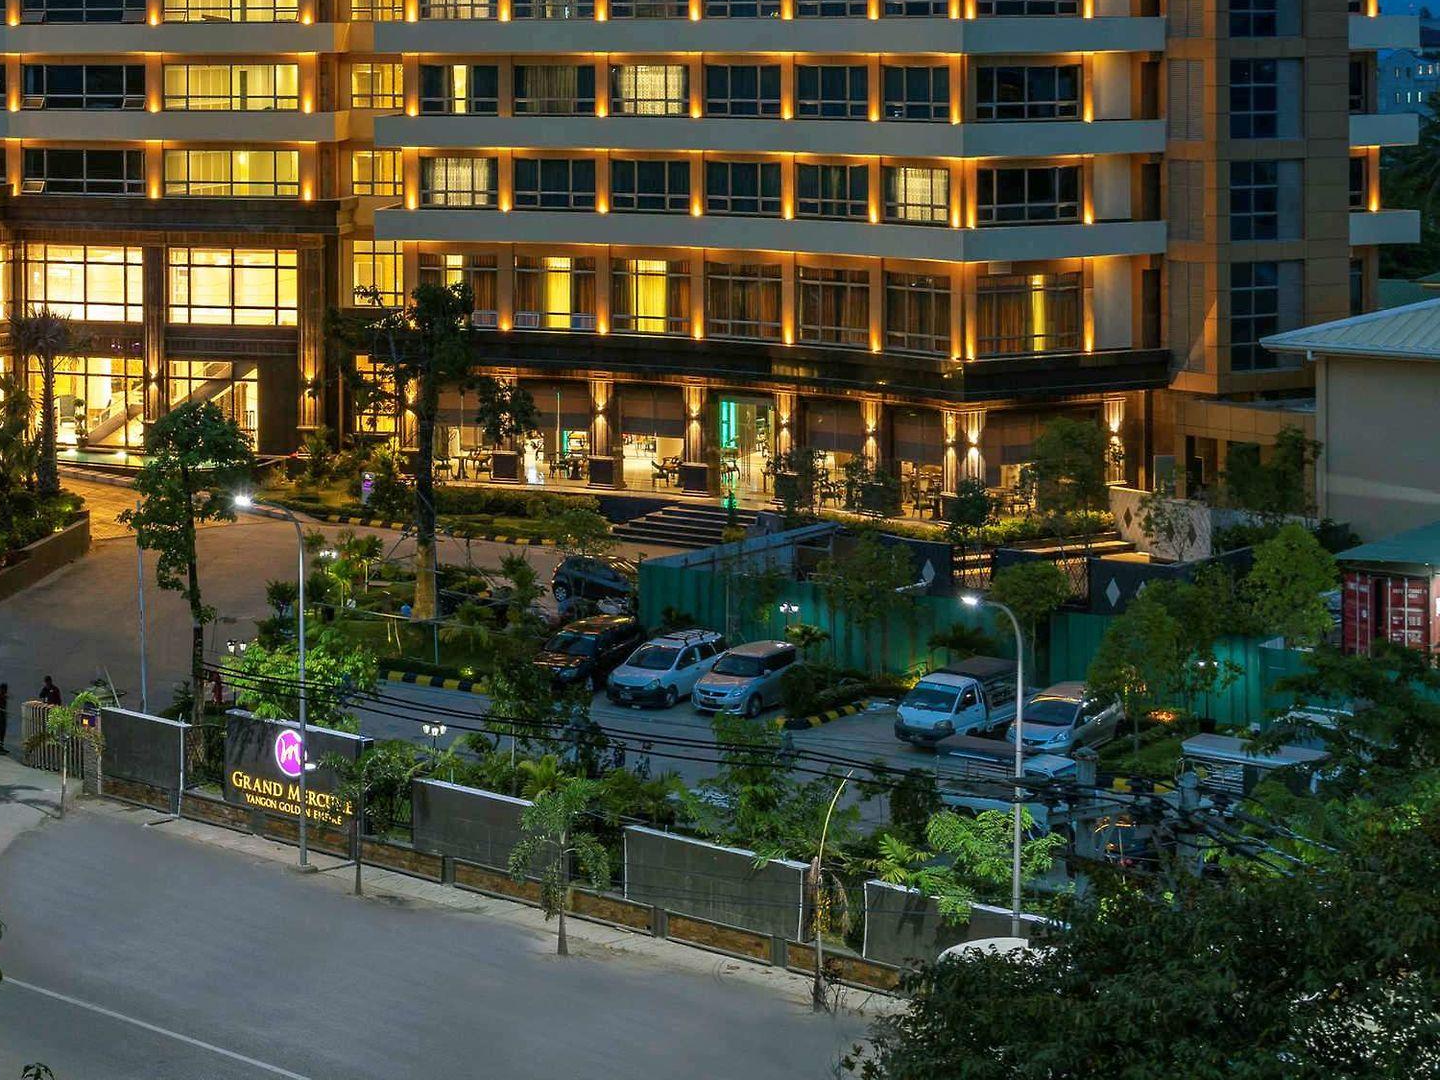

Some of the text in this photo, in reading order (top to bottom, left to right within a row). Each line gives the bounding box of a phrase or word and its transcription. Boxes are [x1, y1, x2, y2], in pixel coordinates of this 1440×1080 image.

[232, 771, 353, 815] GRAND MRCUE
[245, 793, 277, 809] YANGON
[278, 801, 311, 818] GOLDN
